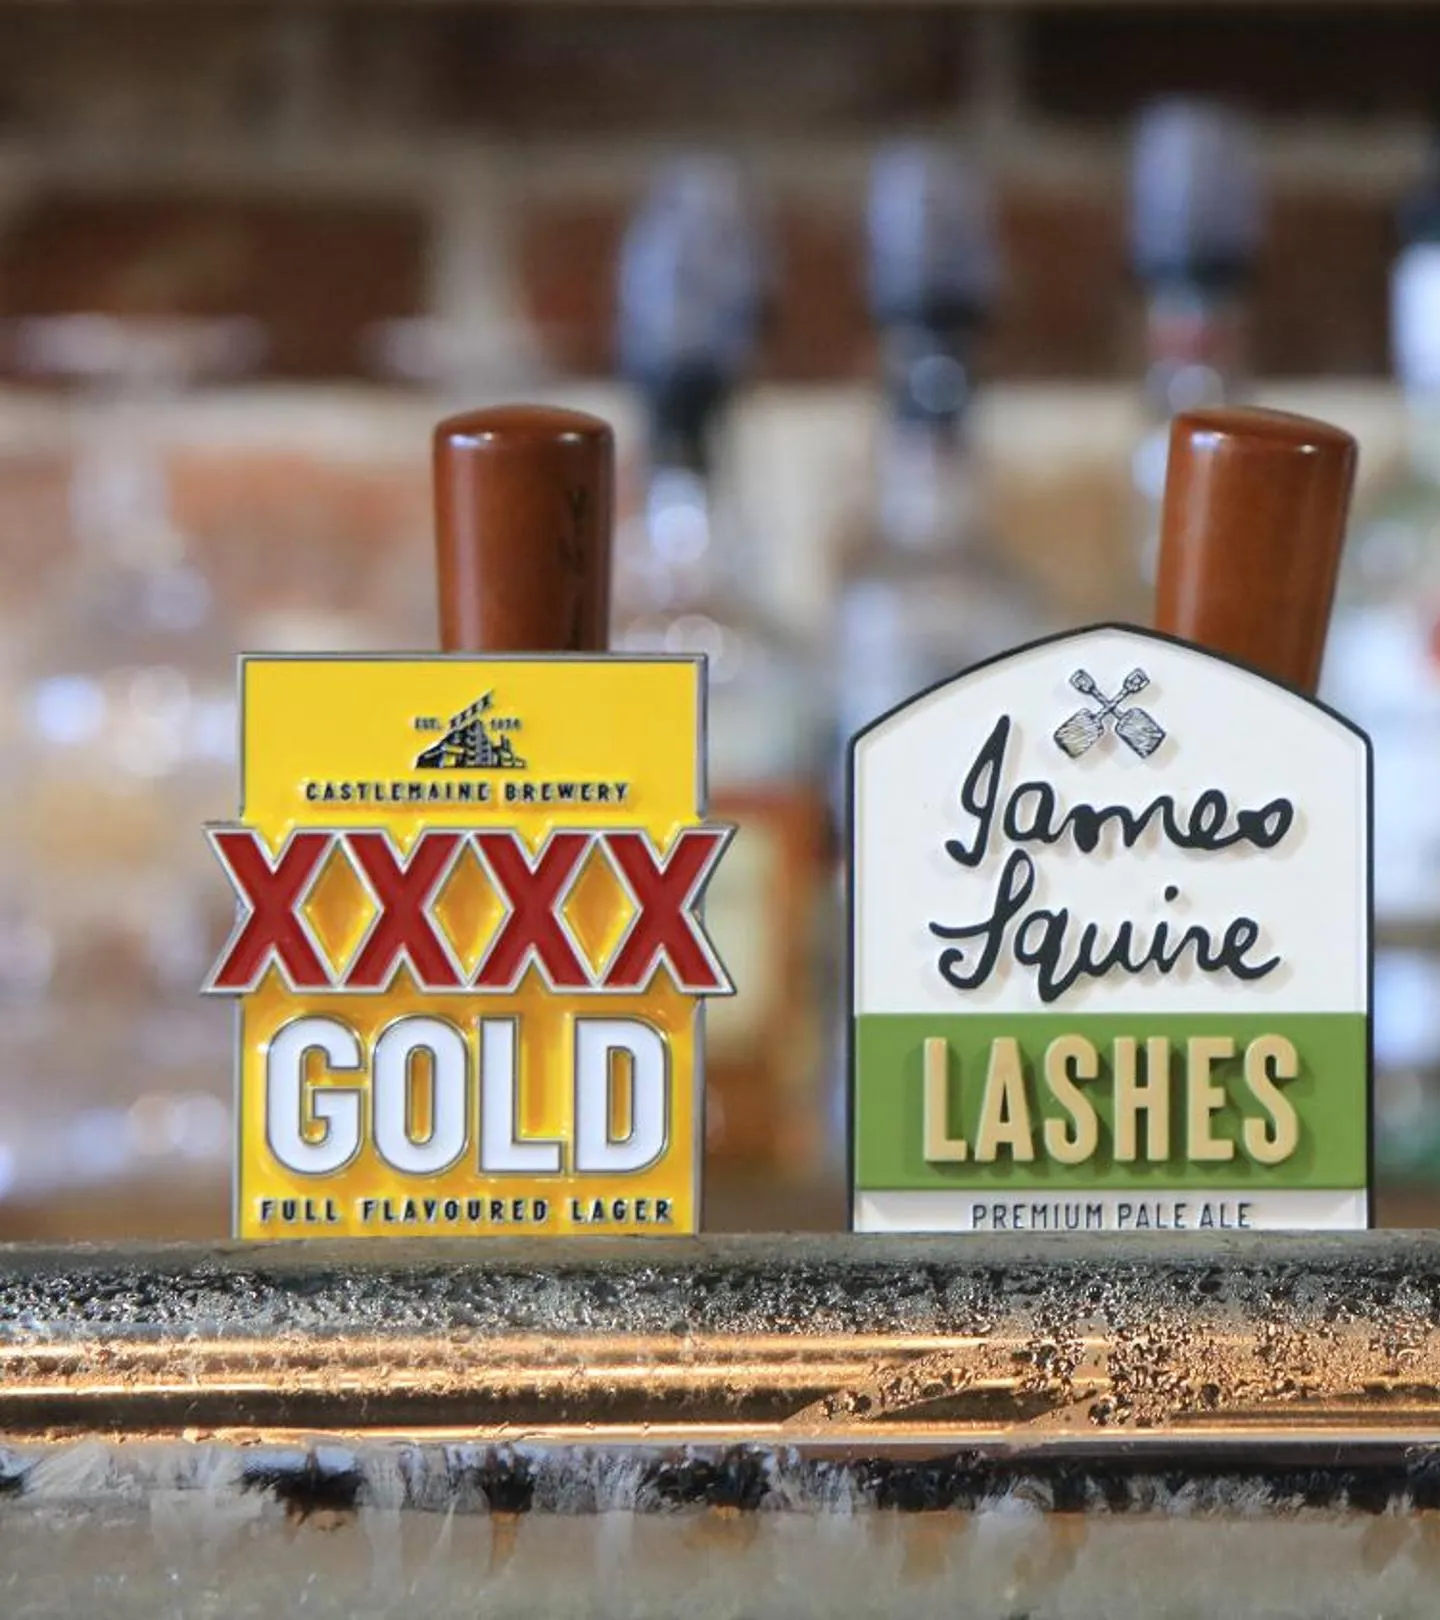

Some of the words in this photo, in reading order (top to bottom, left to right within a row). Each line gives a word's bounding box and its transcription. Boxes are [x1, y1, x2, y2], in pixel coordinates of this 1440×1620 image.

[306, 784, 490, 801] CASTLEMAINE
[505, 784, 628, 801] BREWERY
[945, 715, 1295, 866] James
[202, 826, 735, 995] XXXX
[928, 848, 1281, 1003] Squire
[265, 1014, 670, 1177] GOLD
[922, 1034, 1299, 1164] LASHES
[261, 1201, 338, 1221] FULL
[363, 1201, 546, 1221] FLAVOURED
[571, 1201, 674, 1221] LAGER
[972, 1204, 1103, 1229] PREMIUM
[1118, 1202, 1186, 1228] PALE
[1199, 1202, 1252, 1228] ALE
